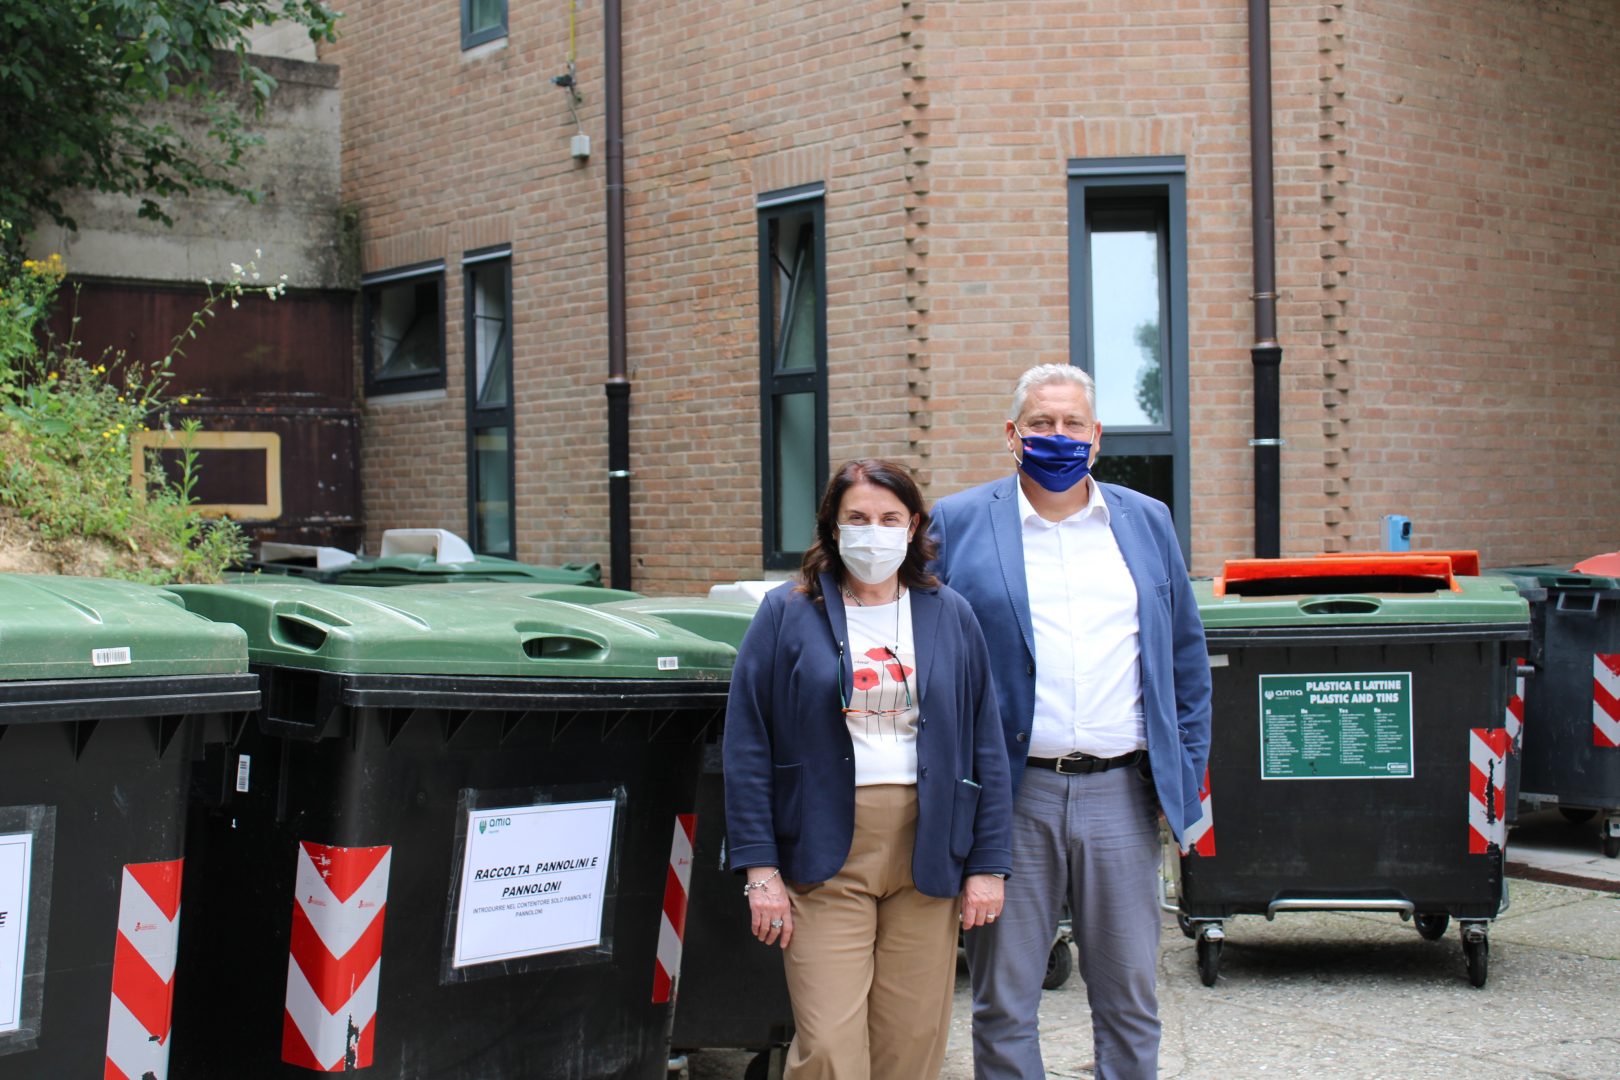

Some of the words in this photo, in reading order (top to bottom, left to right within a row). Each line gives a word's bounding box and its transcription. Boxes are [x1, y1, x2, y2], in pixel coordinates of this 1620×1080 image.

[1306, 681, 1352, 691] PLASTICA
[1354, 681, 1360, 691] E
[1363, 680, 1401, 690] LATTINE
[1310, 694, 1349, 704] PLASTIC
[1351, 693, 1373, 703] AND
[1376, 692, 1399, 703] TINS
[475, 865, 530, 880] RACCOLTA
[535, 858, 589, 873] PANNOLINI
[591, 857, 598, 867] E
[502, 881, 562, 897] PANNOLONI
[473, 904, 506, 914] INTRODURRE
[517, 898, 550, 909] CONTENITORE
[551, 897, 563, 905] SOLO
[515, 908, 543, 917] PANNOLONI
